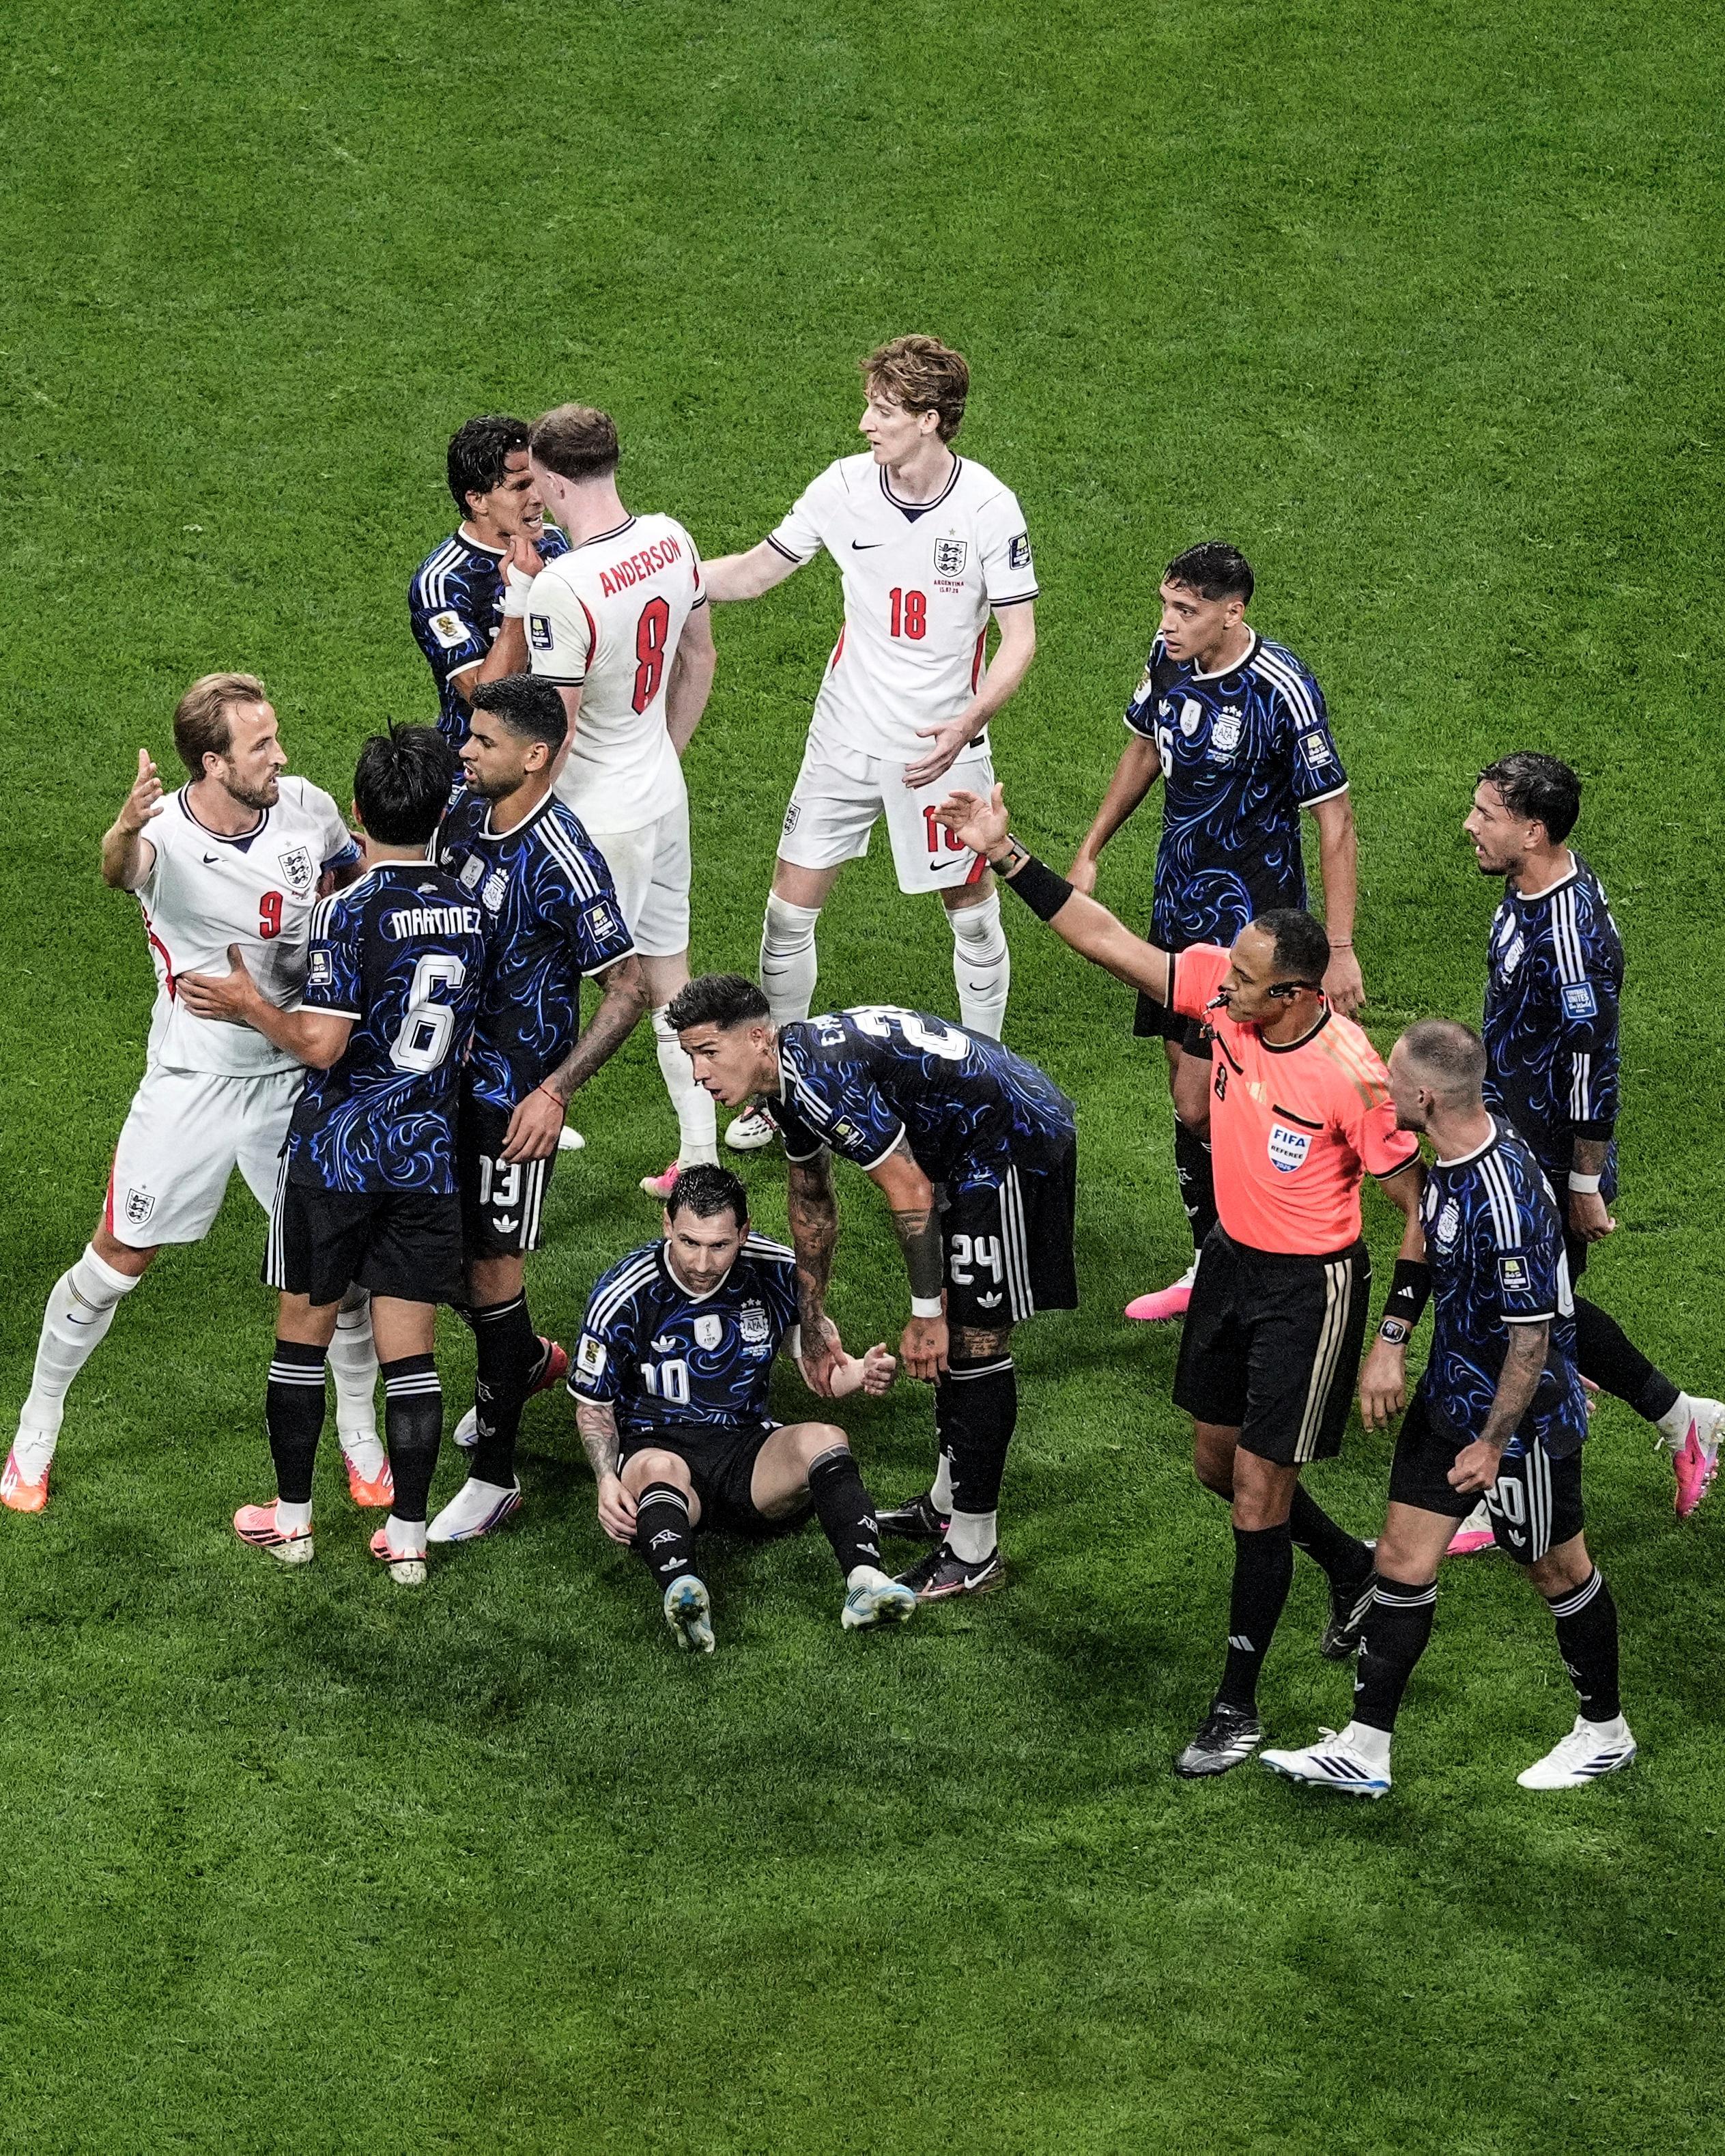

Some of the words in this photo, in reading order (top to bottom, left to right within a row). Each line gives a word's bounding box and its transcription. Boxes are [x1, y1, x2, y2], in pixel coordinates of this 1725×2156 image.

[599, 535, 681, 598] ANDERSON
[889, 587, 926, 640] 18
[631, 596, 670, 715] 8
[259, 891, 283, 939] 9
[389, 954, 466, 1075] 6
[1271, 1145, 1303, 1159] REFEREE
[1274, 1129, 1305, 1147] FIFA
[479, 1154, 521, 1207] 13
[1277, 1161, 1292, 1170] 2026
[950, 1234, 1003, 1285] 24
[640, 1359, 690, 1405] 10
